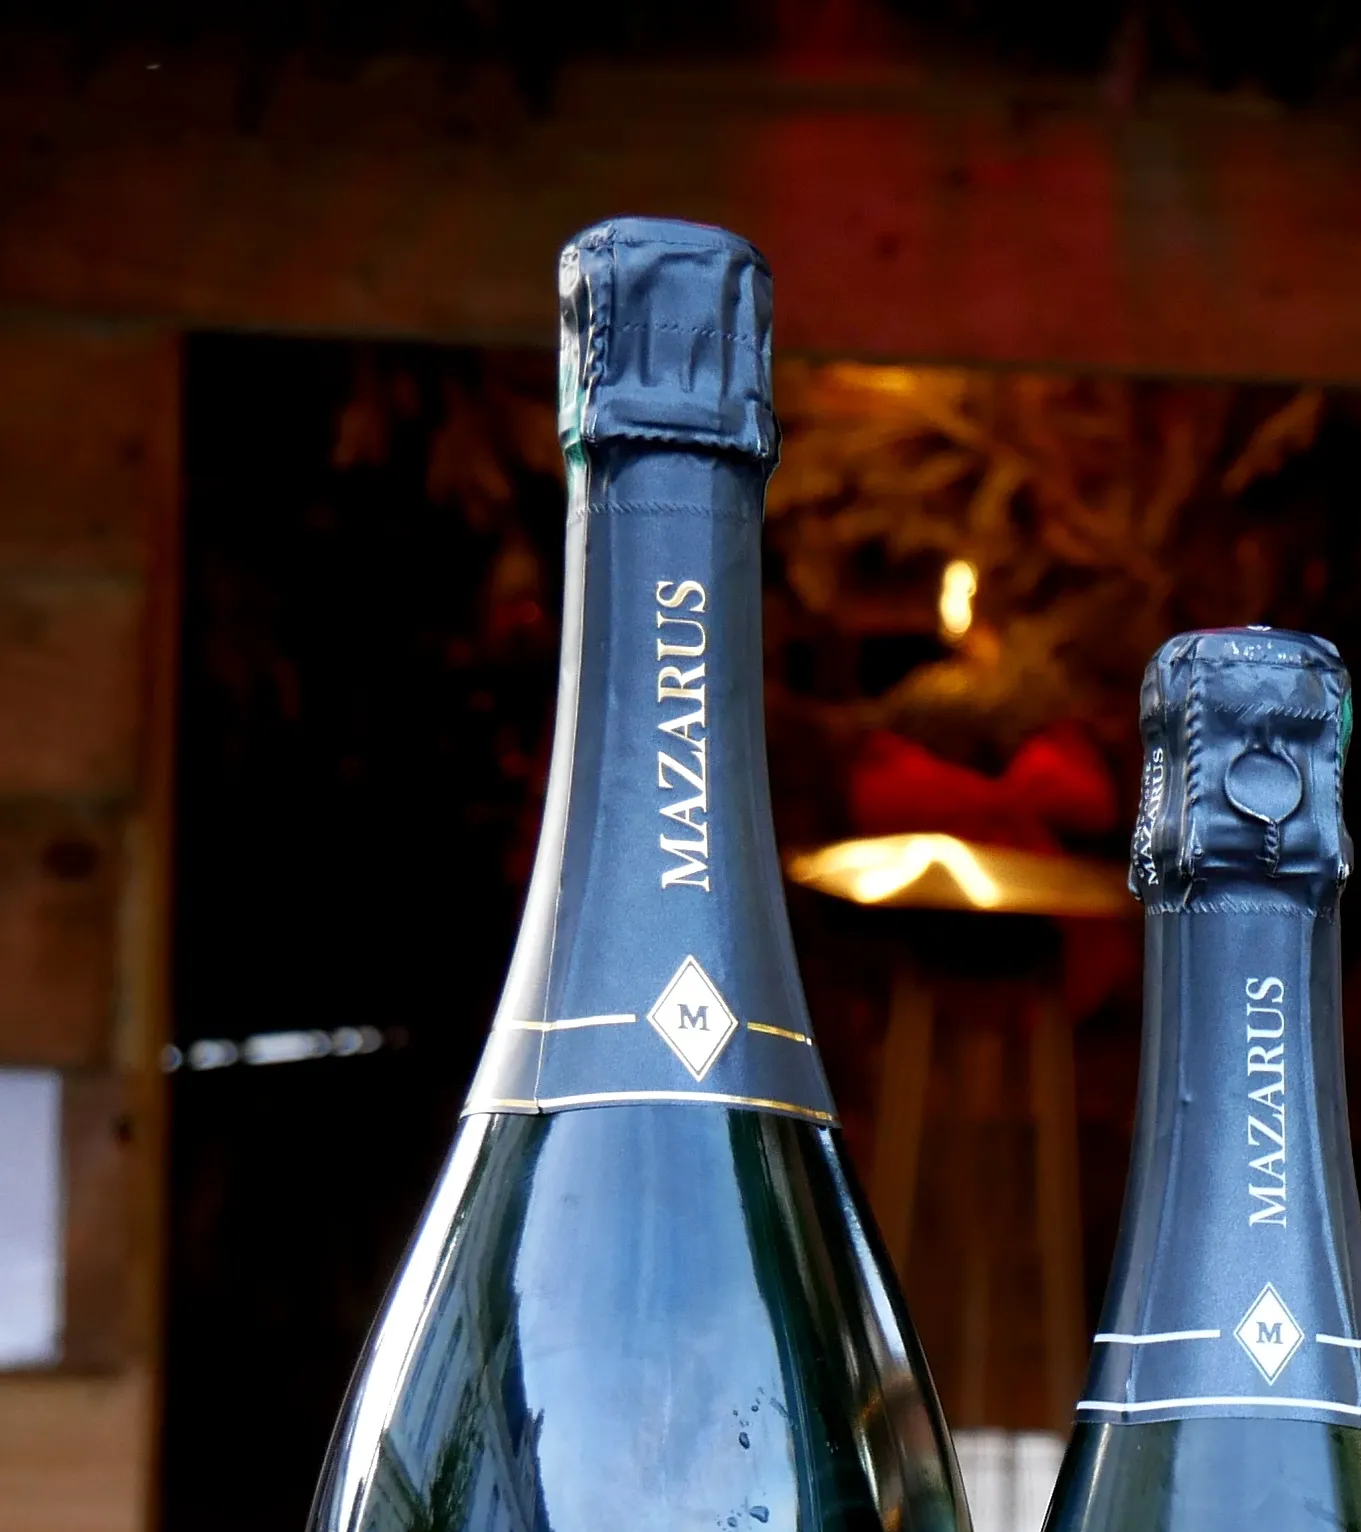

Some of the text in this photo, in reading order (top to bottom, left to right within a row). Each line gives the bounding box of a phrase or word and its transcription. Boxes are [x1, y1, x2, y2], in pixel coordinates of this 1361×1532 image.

[657, 579, 709, 892] MAZARUS
[1140, 747, 1163, 885] MAZARUS
[677, 1003, 710, 1032] M
[1246, 976, 1287, 1228] MAZARUS
[1256, 1321, 1283, 1344] M
